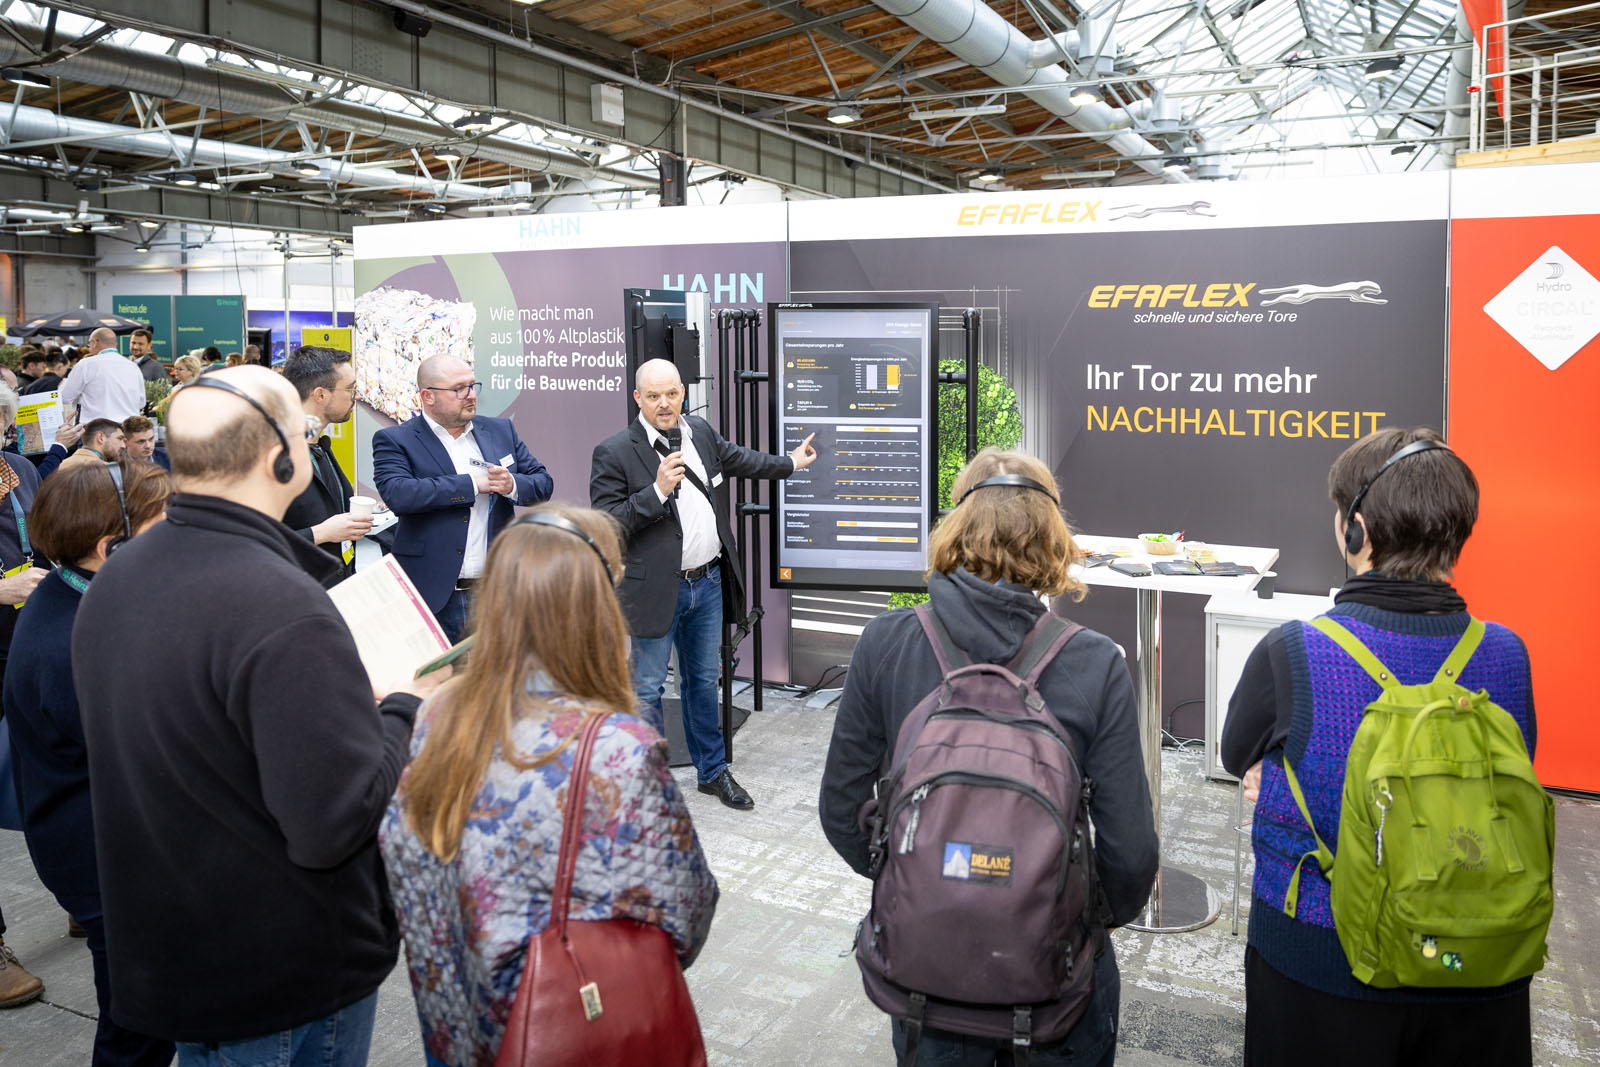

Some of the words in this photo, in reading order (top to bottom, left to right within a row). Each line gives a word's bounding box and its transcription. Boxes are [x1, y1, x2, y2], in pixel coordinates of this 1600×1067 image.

[957, 200, 1103, 227] EFAFLEX
[519, 215, 581, 239] HAHN
[663, 272, 764, 304] HAHN
[1088, 282, 1257, 309] EFAFLEX
[1536, 282, 1573, 294] Hydro
[489, 305, 515, 321] Wie
[518, 304, 560, 321] macht
[564, 307, 594, 320] man
[1133, 311, 1186, 324] schnelle
[1188, 311, 1215, 323] und
[1215, 310, 1264, 323] sichere
[1267, 310, 1298, 323] Tore
[490, 332, 513, 345] aus
[558, 327, 625, 347] Altplastik
[490, 350, 568, 367] dauerhafte
[491, 373, 512, 390] für
[514, 374, 536, 390] die
[540, 374, 622, 391] Bauwende?
[1087, 364, 1124, 391] Ihr
[1131, 364, 1182, 392] Tor
[1190, 372, 1222, 393] zu
[1234, 366, 1318, 394] mehr
[1087, 405, 1387, 439] NACHHALTIGKEIT
